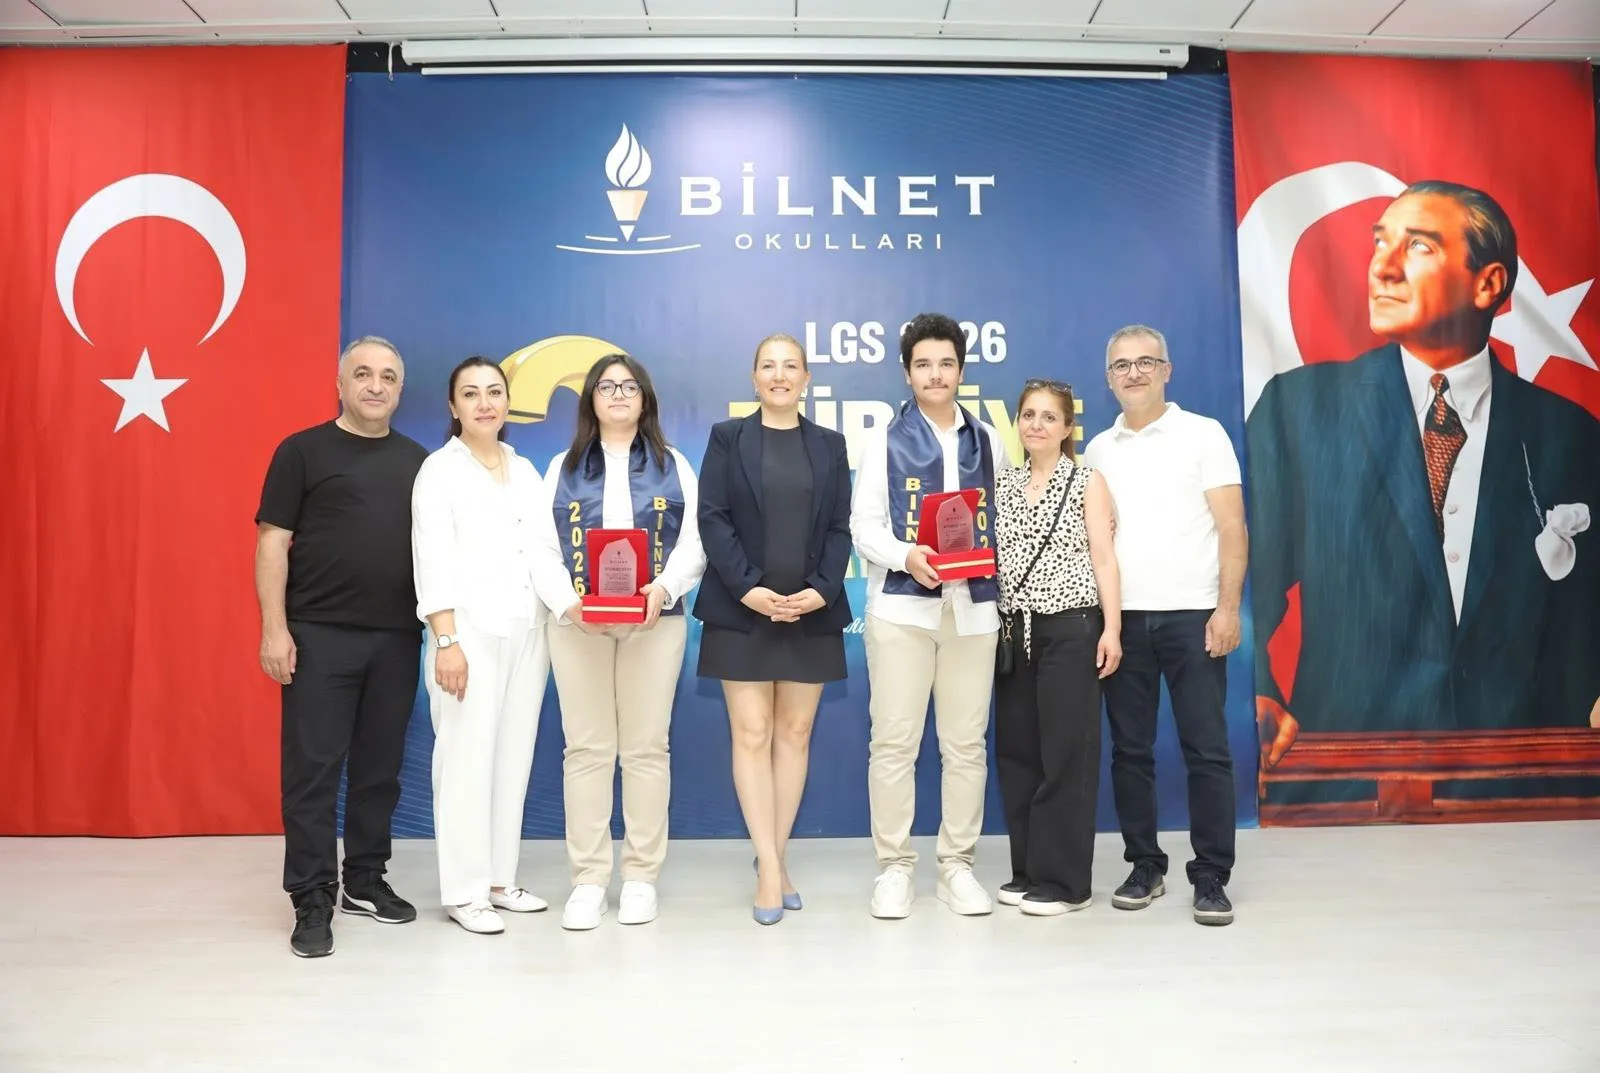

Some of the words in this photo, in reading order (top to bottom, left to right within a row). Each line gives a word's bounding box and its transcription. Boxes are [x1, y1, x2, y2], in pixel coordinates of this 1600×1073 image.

[679, 161, 995, 218] BİLNET
[734, 233, 943, 250] OKULLARI
[805, 321, 886, 364] LGS
[899, 321, 1008, 364] 26
[568, 501, 586, 597] 2026
